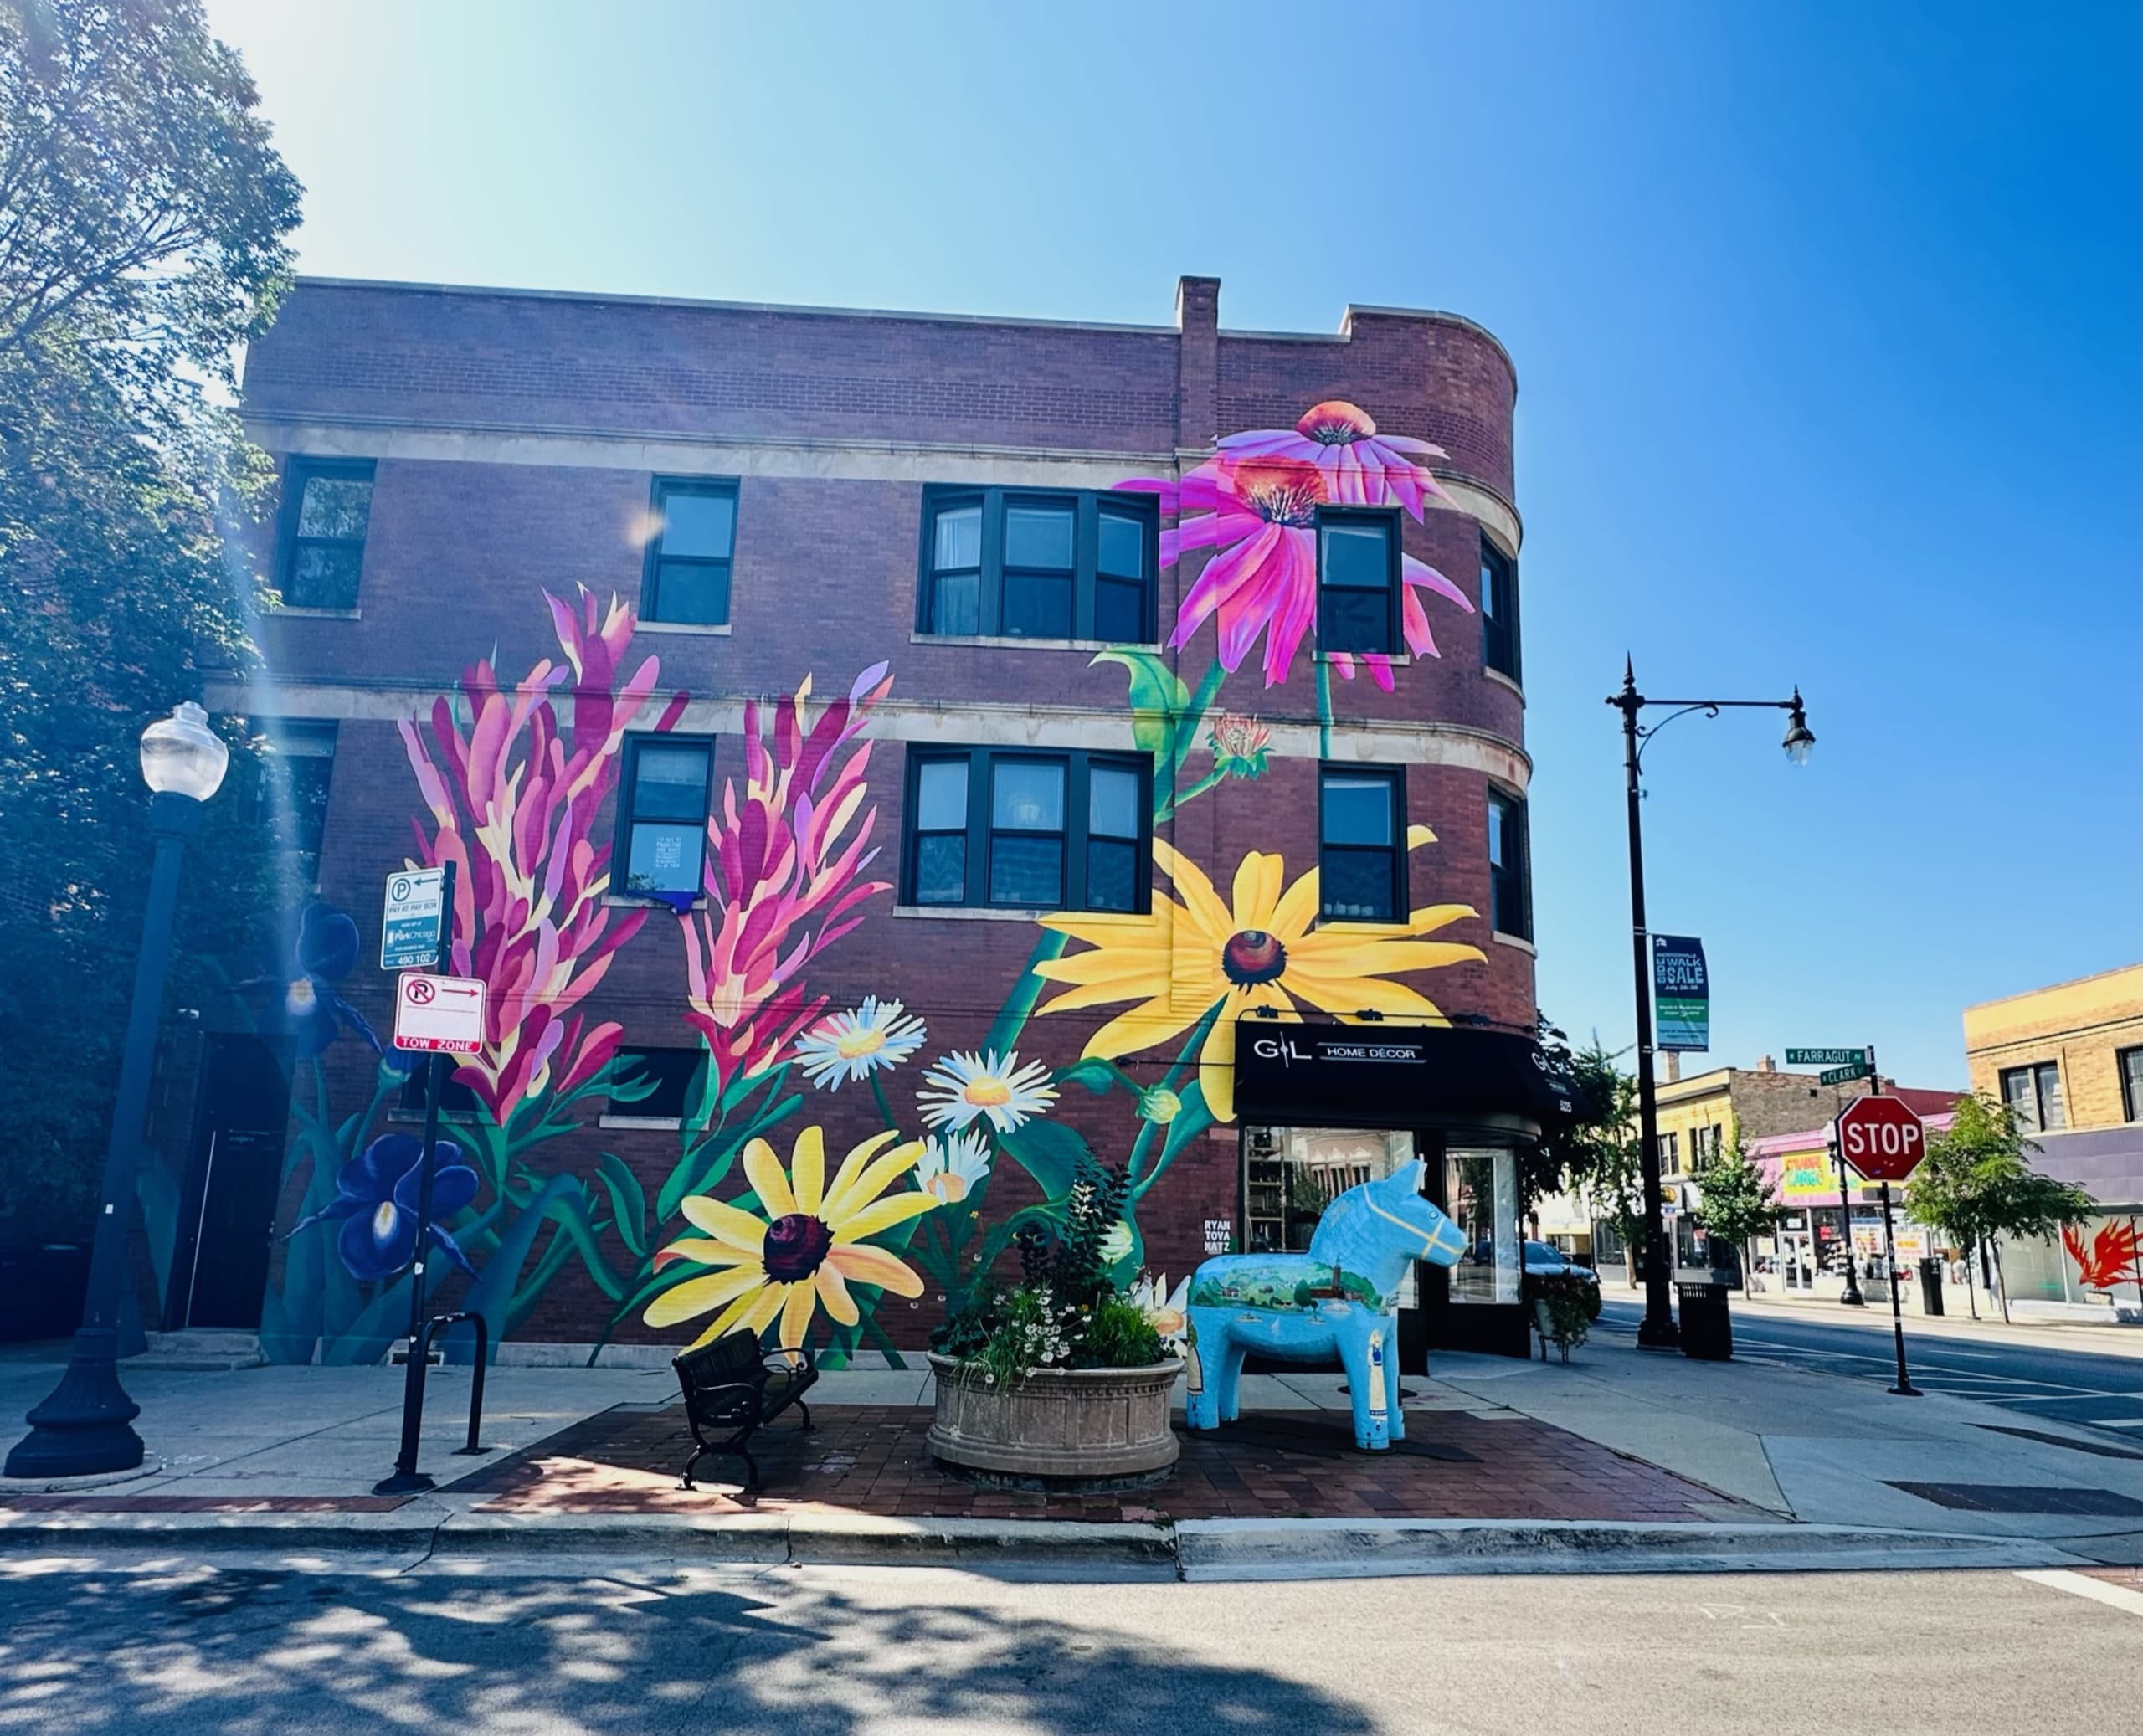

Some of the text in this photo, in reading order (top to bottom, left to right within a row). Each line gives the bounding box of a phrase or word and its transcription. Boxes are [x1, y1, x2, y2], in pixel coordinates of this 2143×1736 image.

[398, 955, 414, 964] 490
[416, 953, 431, 963] 102
[1667, 958, 1701, 966] WALK
[1657, 958, 1666, 984] SIDE
[1667, 967, 1704, 984] SALE
[402, 1038, 472, 1051] TOW ZONE
[1327, 1047, 1366, 1057] HOME
[1797, 1050, 1850, 1062] FARRAGUT
[1828, 1067, 1857, 1083] CLARK
[1848, 1122, 1919, 1155] STOP
[1205, 1220, 1231, 1230] RYAN
[1205, 1230, 1231, 1240] TOVA
[1205, 1241, 1231, 1252] KATZ
